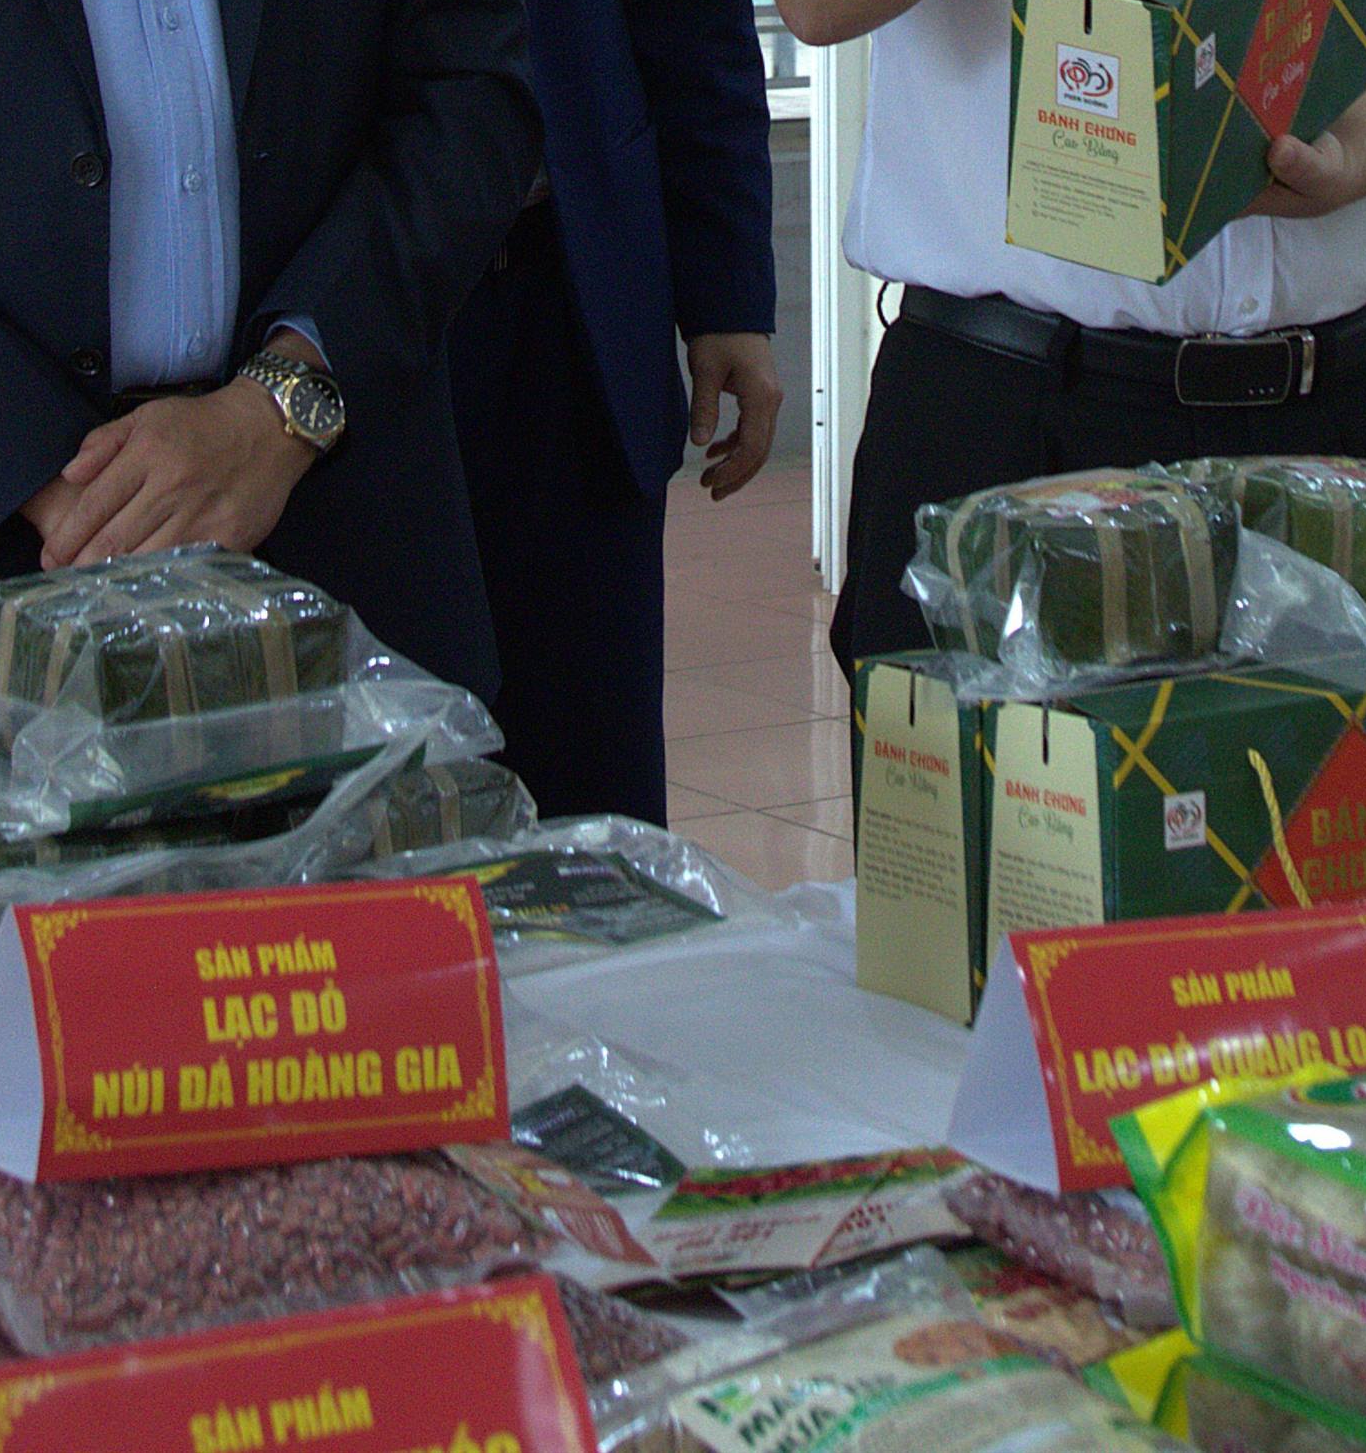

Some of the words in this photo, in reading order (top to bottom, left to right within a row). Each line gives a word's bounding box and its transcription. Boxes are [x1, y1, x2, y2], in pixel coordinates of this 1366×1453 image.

[194, 940, 253, 981] SẢN
[256, 932, 337, 977] PHẨM
[1170, 968, 1222, 1008] SẢN
[1224, 960, 1296, 1002] PHẨM
[202, 991, 279, 1050] LẠC
[290, 977, 348, 1036] ĐỎ
[92, 1061, 165, 1119] NÚI
[178, 1053, 235, 1113] ĐÁ
[246, 1048, 384, 1107] HOÀNG
[394, 1043, 463, 1094] GIA
[1073, 1047, 1142, 1100] LẠC
[269, 1380, 374, 1445] PHẨM
